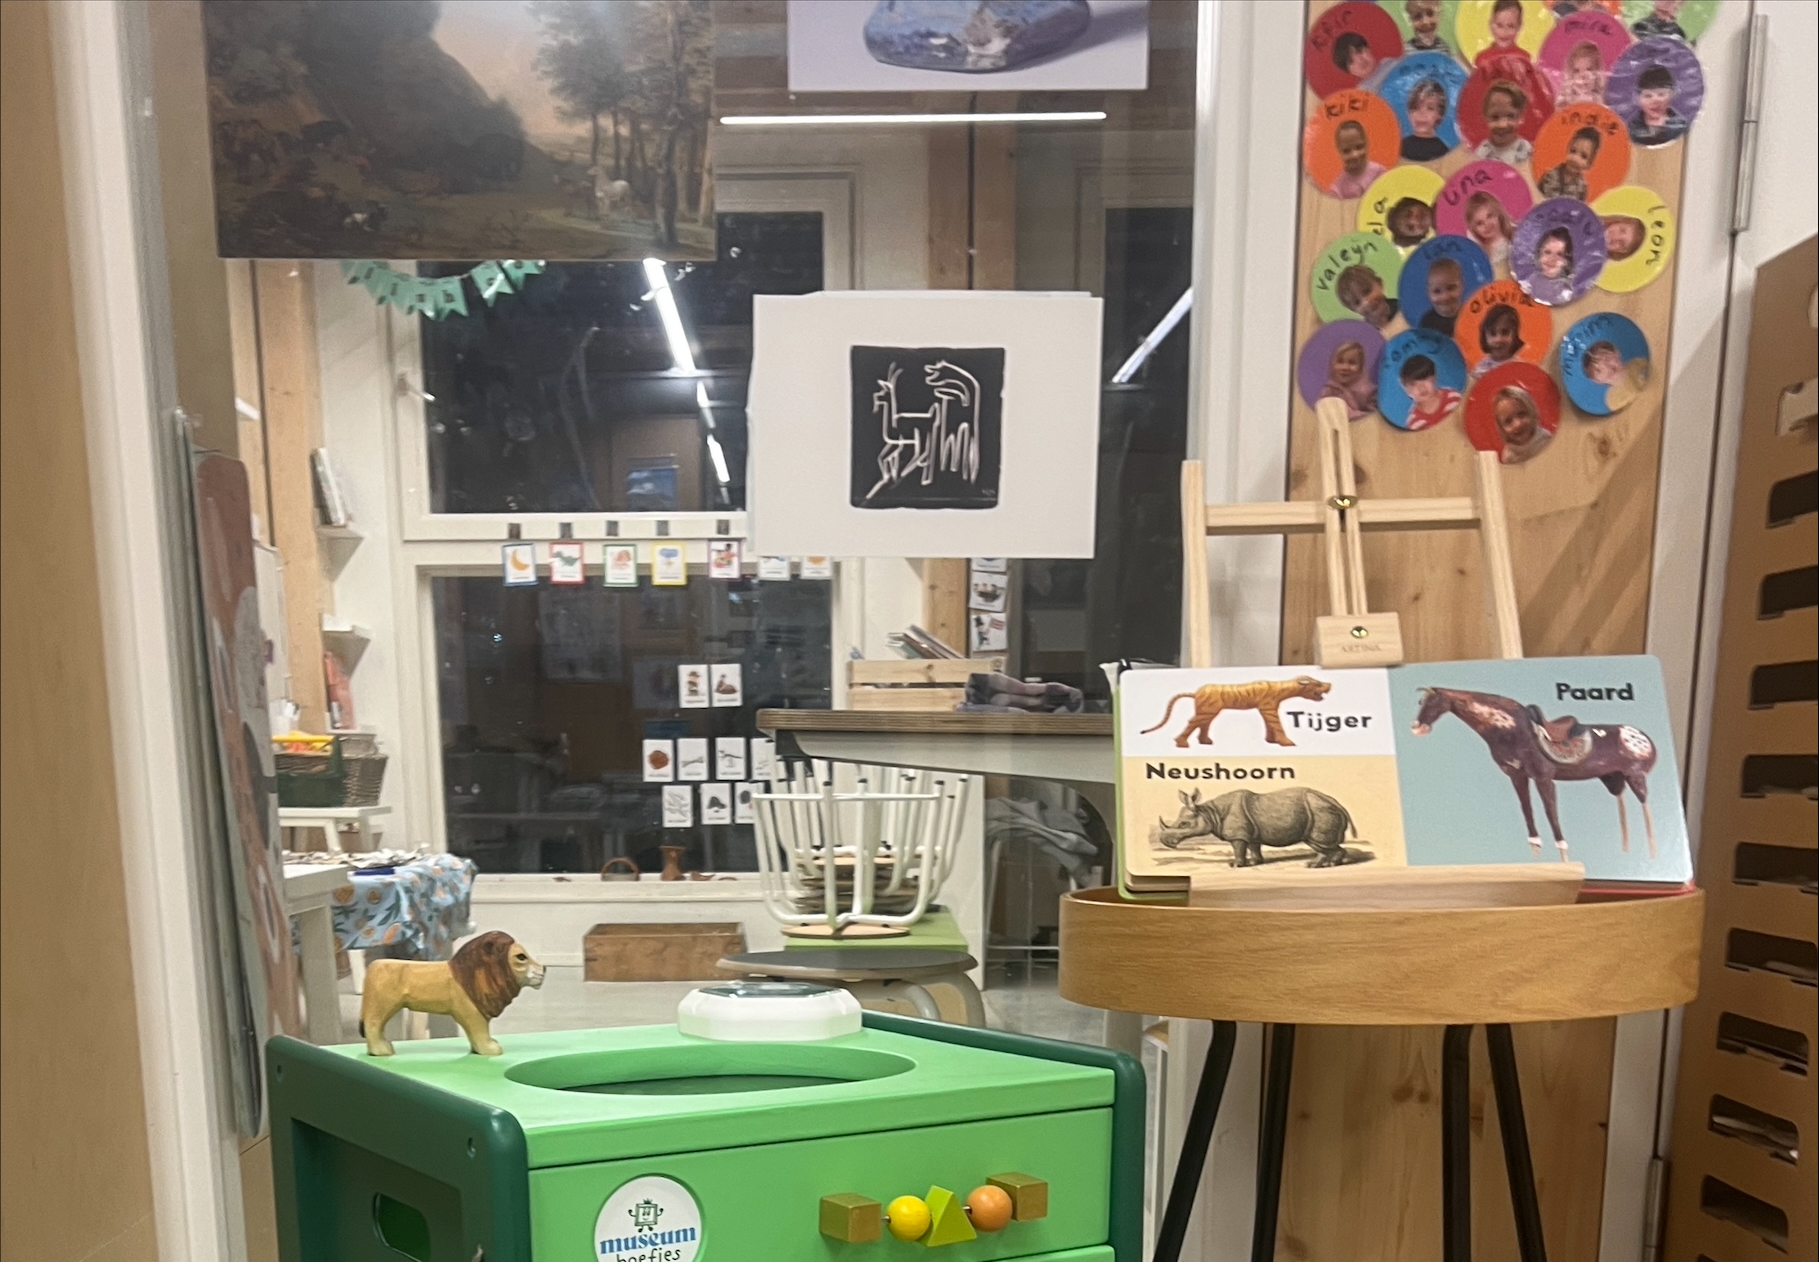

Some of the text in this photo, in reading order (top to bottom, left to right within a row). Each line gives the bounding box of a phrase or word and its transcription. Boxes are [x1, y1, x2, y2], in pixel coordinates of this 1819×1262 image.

[1555, 682, 1634, 701] Paard
[1287, 711, 1373, 732] Tijger
[1145, 762, 1295, 780] Neushoorn
[600, 1227, 696, 1254] museum
